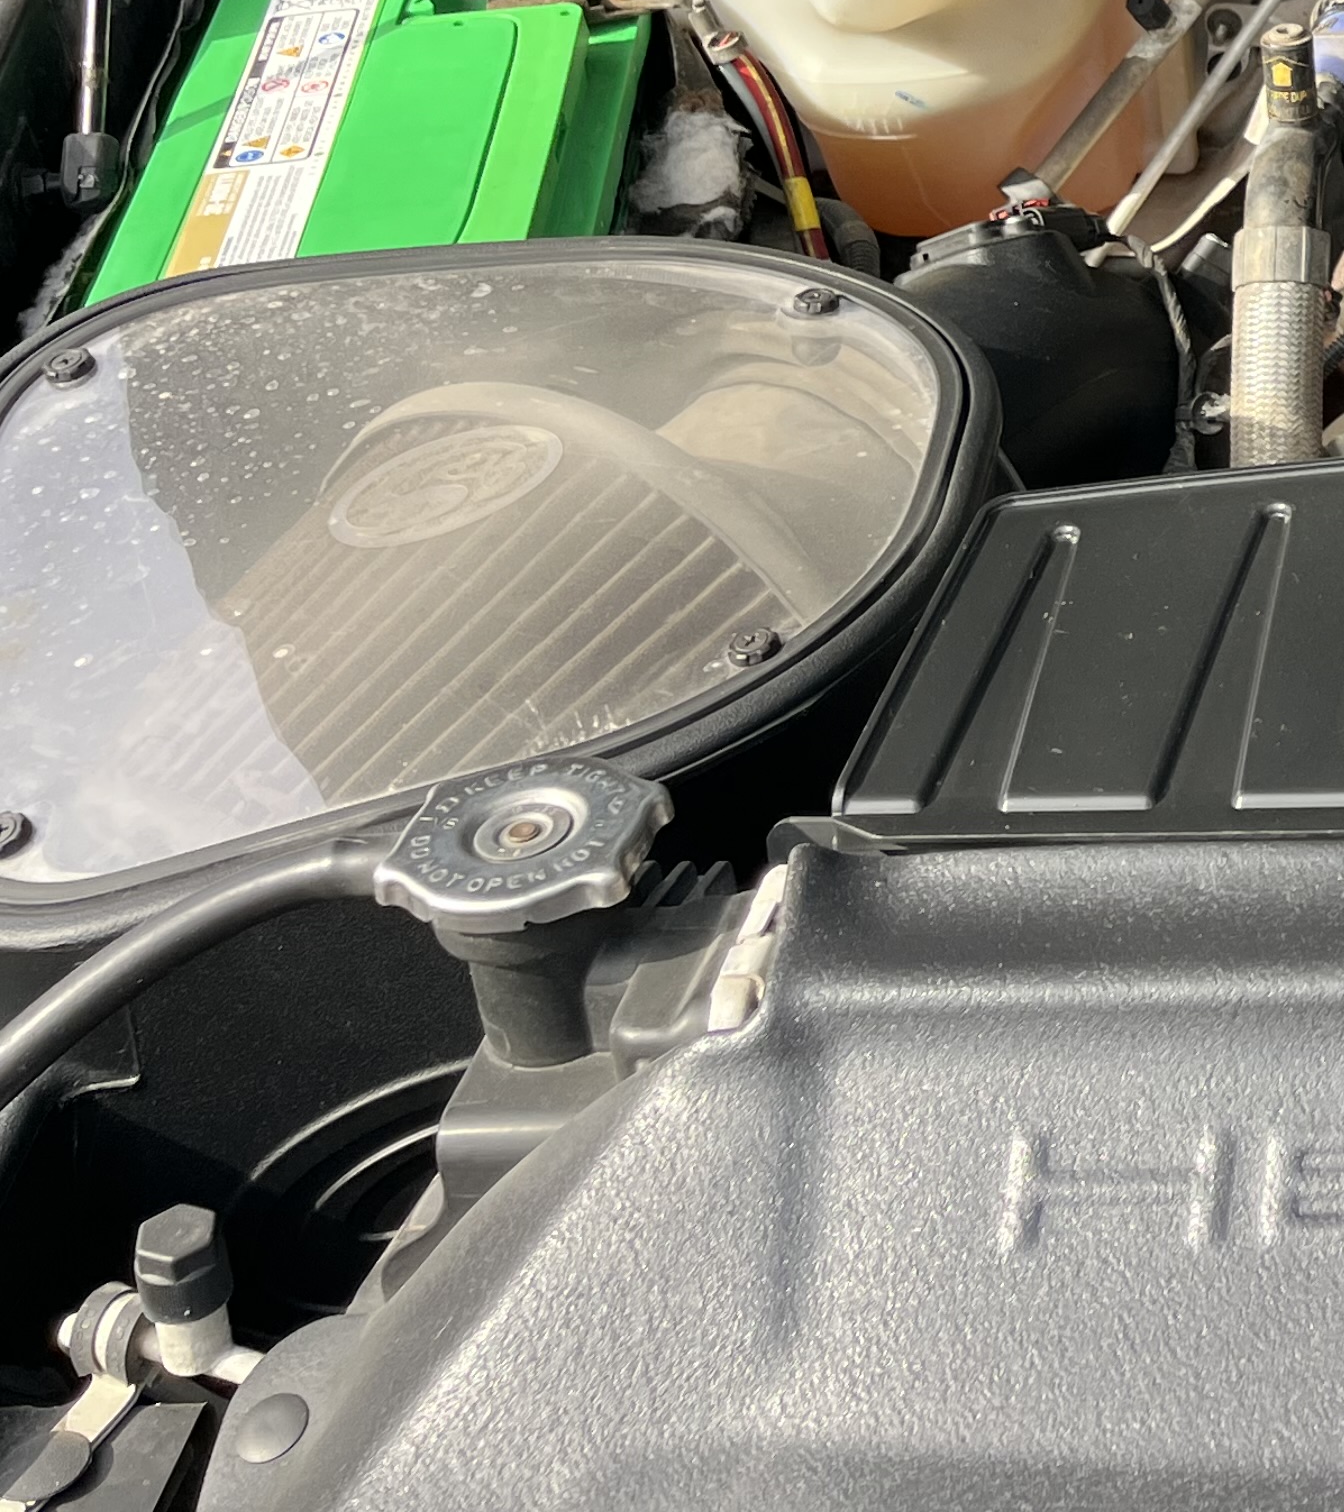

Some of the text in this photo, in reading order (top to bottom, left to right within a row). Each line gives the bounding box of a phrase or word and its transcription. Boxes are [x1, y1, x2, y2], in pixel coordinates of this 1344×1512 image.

[464, 763, 627, 796] KEEP TIGHT
[410, 835, 606, 894] DO NOT OPEN HOT
